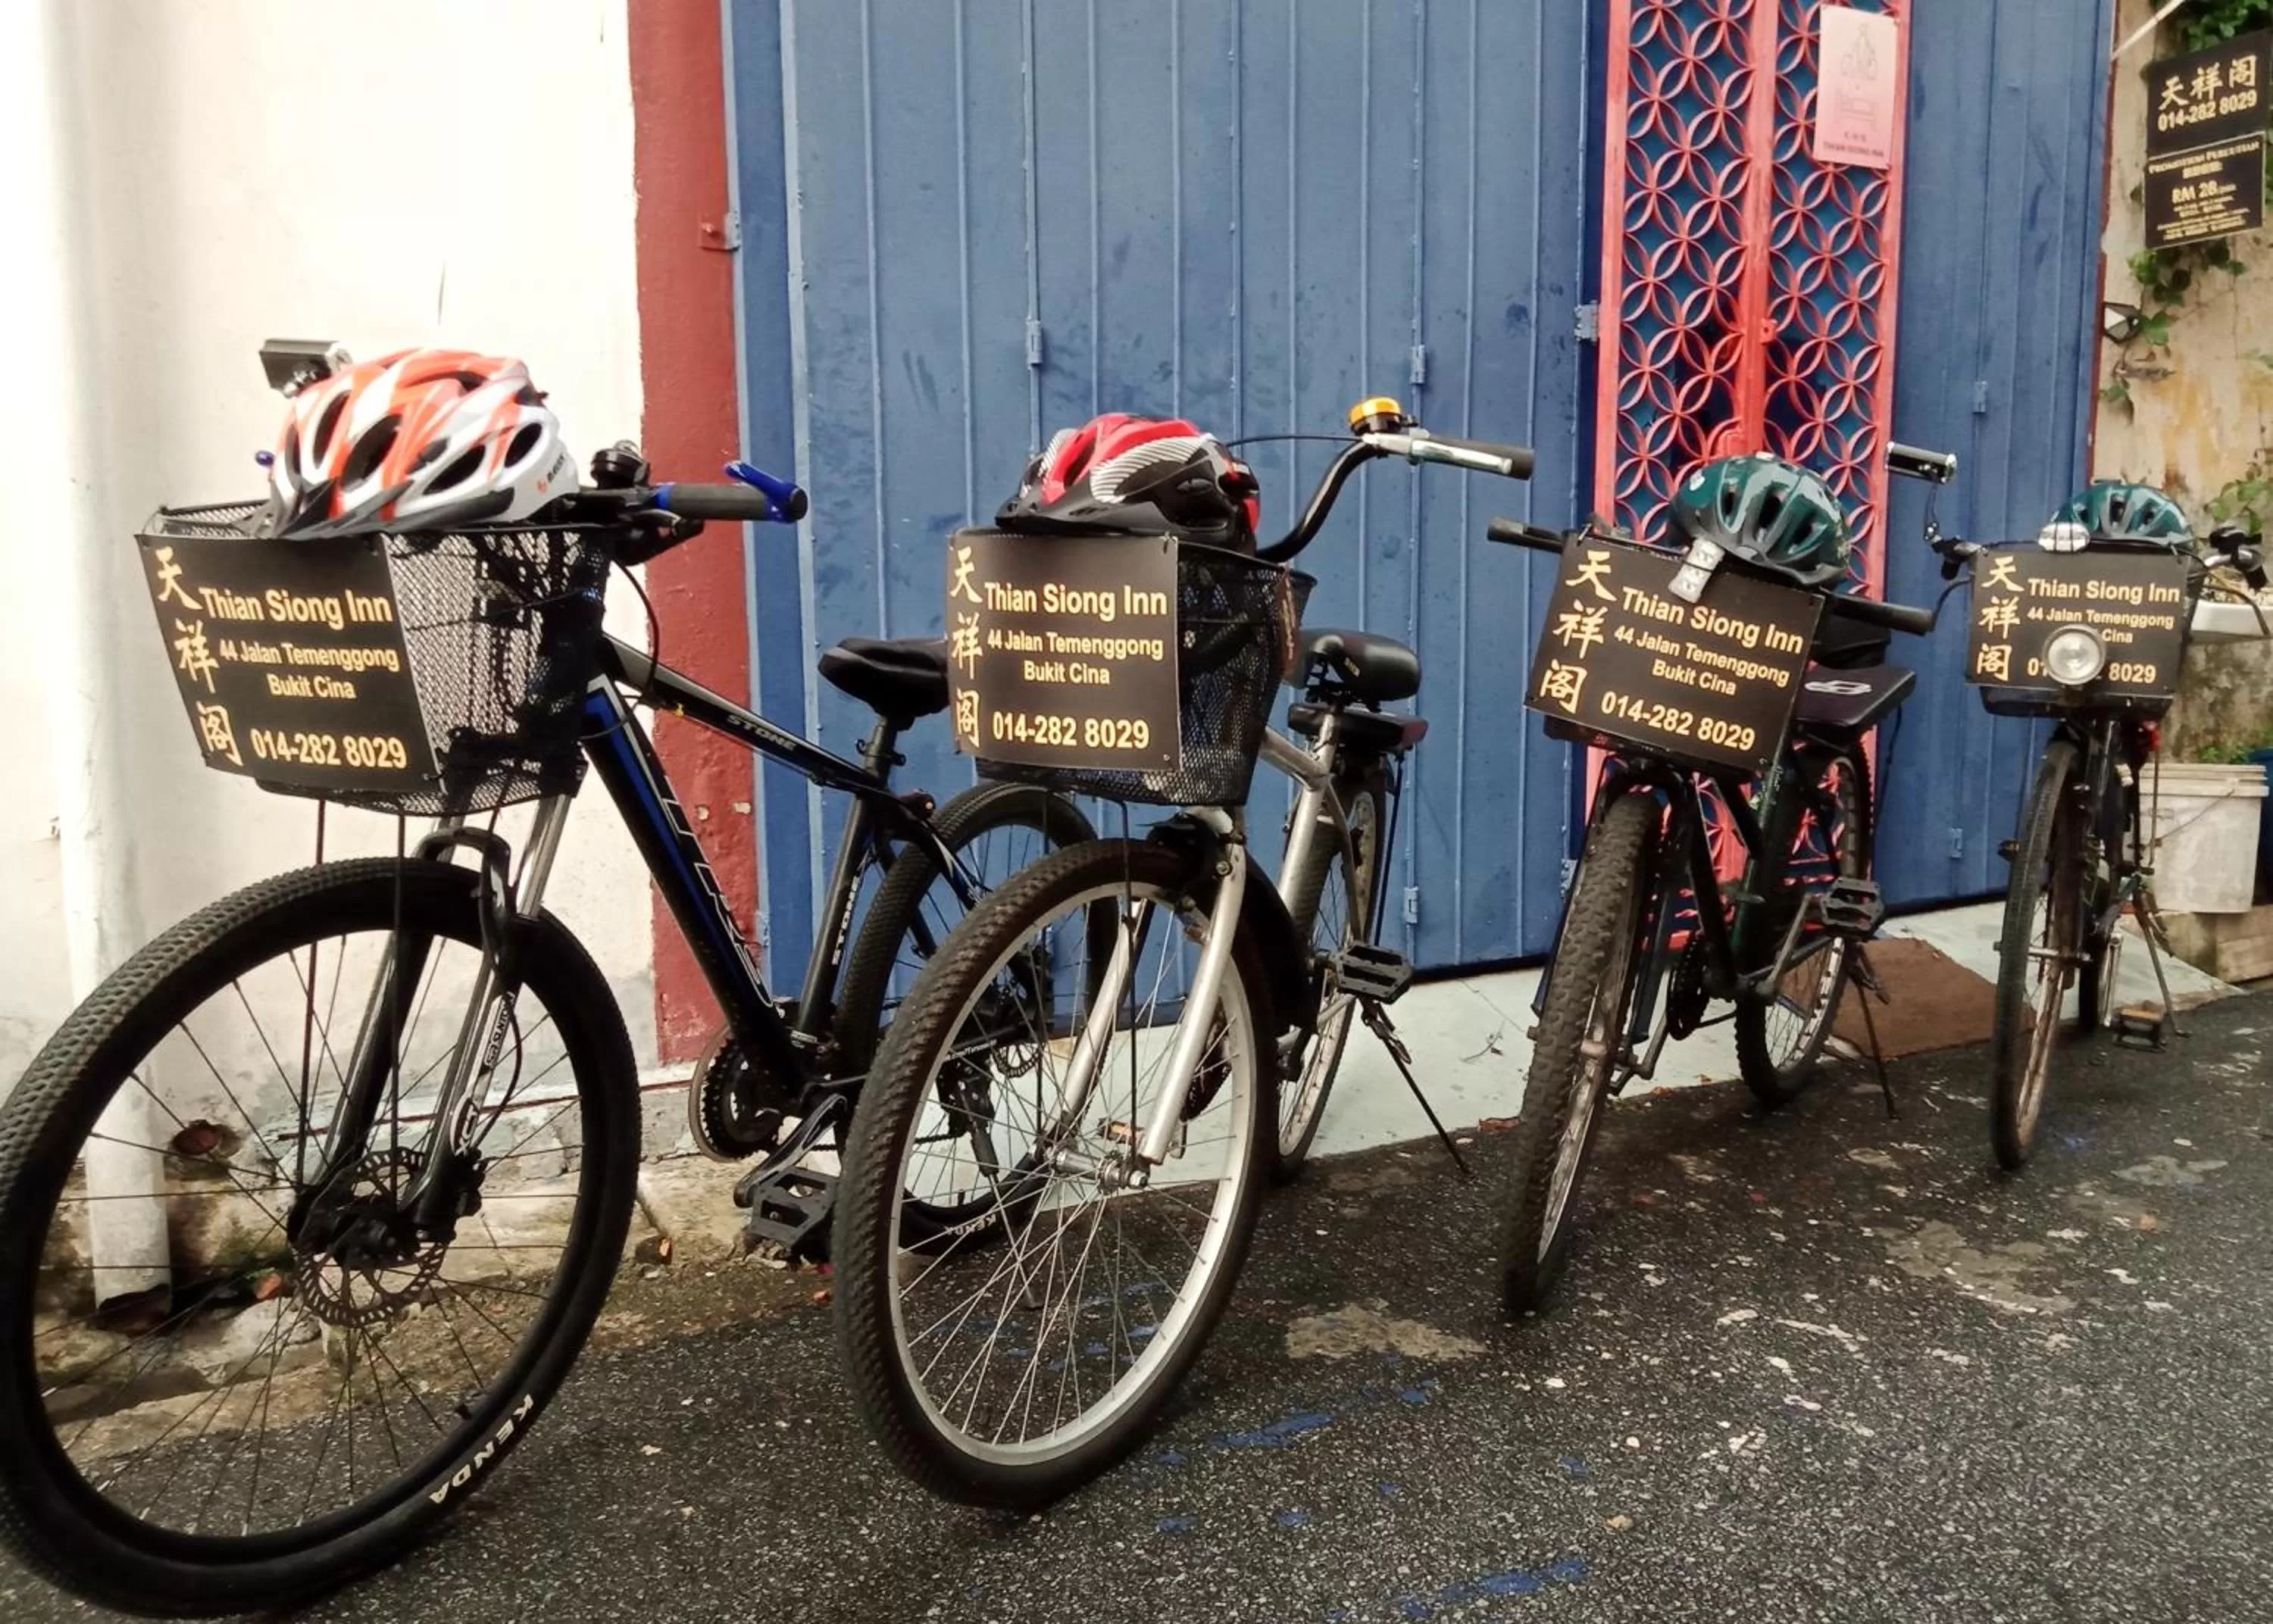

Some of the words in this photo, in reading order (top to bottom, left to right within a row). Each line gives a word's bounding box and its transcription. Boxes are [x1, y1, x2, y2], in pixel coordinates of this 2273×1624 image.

[2158, 55, 2257, 111] 天祥阁
[2158, 101, 2216, 132] 014-282
[2219, 89, 2257, 115] 8029
[199, 587, 262, 620] Thian
[265, 589, 344, 630] Siong
[346, 590, 392, 622] Inn
[985, 582, 1036, 612] Thian
[1043, 584, 1115, 621] Siong
[1124, 586, 1167, 614] Inn
[2028, 579, 2079, 599] Thian
[2086, 580, 2143, 605] Siong
[2149, 583, 2180, 603] Inn
[1540, 550, 1617, 714] 天祥阁
[1621, 587, 1684, 624] Thian
[1690, 606, 1760, 648] Siong
[1765, 623, 1803, 654] Inn
[1976, 556, 2024, 681] 天祥阁
[2028, 606, 2043, 620] 44
[2046, 608, 2081, 623] Jalan
[2087, 610, 2175, 629] Temenggong
[2102, 628, 2133, 644] Cina
[155, 546, 243, 766] 天祥阁
[219, 639, 238, 661] 44
[240, 640, 281, 664] Jalan
[282, 642, 399, 672] Temenggong
[950, 546, 983, 748] 天祥阁
[987, 629, 1002, 649] 44
[1005, 630, 1043, 651] Jalan
[1047, 632, 1163, 660] Temenggong
[1614, 626, 1634, 645] 44
[1637, 631, 1680, 657] Jalan
[1686, 642, 1790, 688] Temenggong
[267, 673, 312, 698] Bukit
[314, 676, 356, 699] Cina
[1024, 661, 1065, 682] Bukit
[1069, 664, 1109, 684] Cina
[1652, 660, 1696, 687] Bukit
[1699, 673, 1737, 695] Cina
[2109, 663, 2156, 684] 8029
[727, 714, 796, 751] STONE
[993, 712, 1076, 745] 014-282
[1085, 719, 1149, 748] 8029
[1601, 692, 1693, 735] 014-282
[1697, 717, 1756, 751] 8029
[250, 729, 341, 765] 014-282
[343, 736, 406, 768] 8029
[429, 1394, 533, 1504] KENDA
